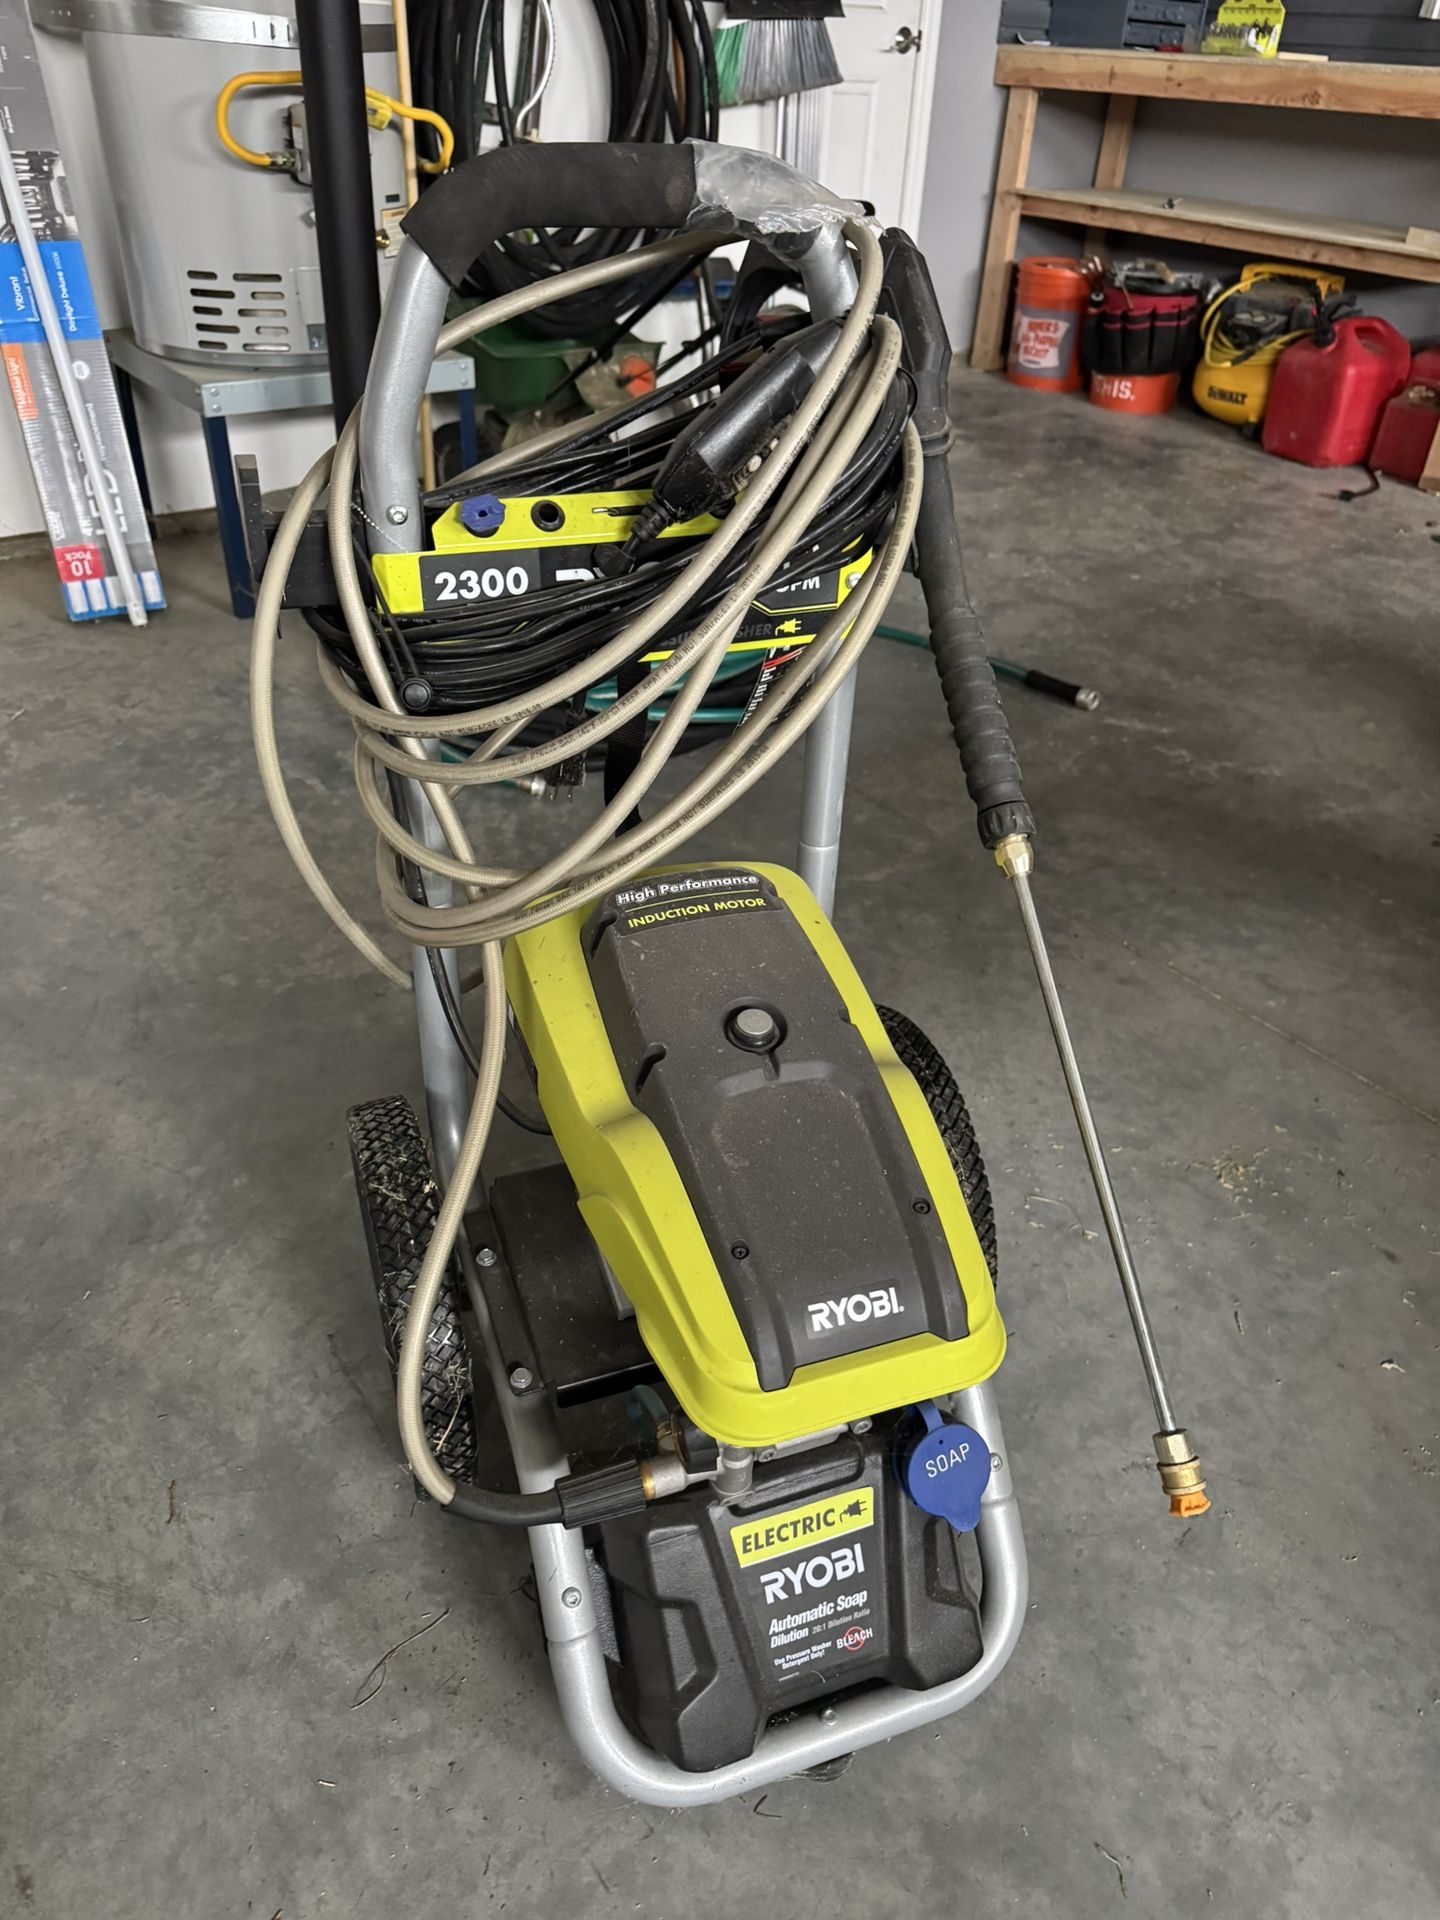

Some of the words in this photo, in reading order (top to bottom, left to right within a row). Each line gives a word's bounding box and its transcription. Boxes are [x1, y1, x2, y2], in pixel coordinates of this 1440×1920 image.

[9, 275, 26, 311] Vibrant
[64, 550, 94, 562] Pack
[70, 560, 93, 578] 10
[434, 566, 529, 601] 2300
[734, 622, 773, 640] SHER
[621, 691, 640, 708] KEEP
[643, 673, 661, 690] AWAY
[663, 655, 682, 673] FROM
[661, 821, 682, 839] FROM
[682, 807, 697, 822] HOT
[699, 778, 735, 809] SURFACES
[616, 886, 656, 906] High
[659, 874, 760, 895] Performance
[627, 903, 711, 928] INDUCTION
[714, 897, 767, 911] MOTOR
[925, 1442, 970, 1478] SOAP
[741, 1507, 836, 1555] ELECTRIC
[759, 1542, 865, 1605] RYOBI
[768, 1601, 835, 1635] Automatic
[836, 1589, 868, 1612] Soap
[770, 1627, 809, 1649] Dilution
[827, 1614, 853, 1629] Dilution
[853, 1607, 871, 1620] Ratio
[773, 1656, 786, 1667] Use
[786, 1648, 811, 1662] Pressure
[811, 1640, 833, 1652] Washer
[836, 1627, 874, 1649] BLEACH
[781, 1655, 811, 1670] Detergent
